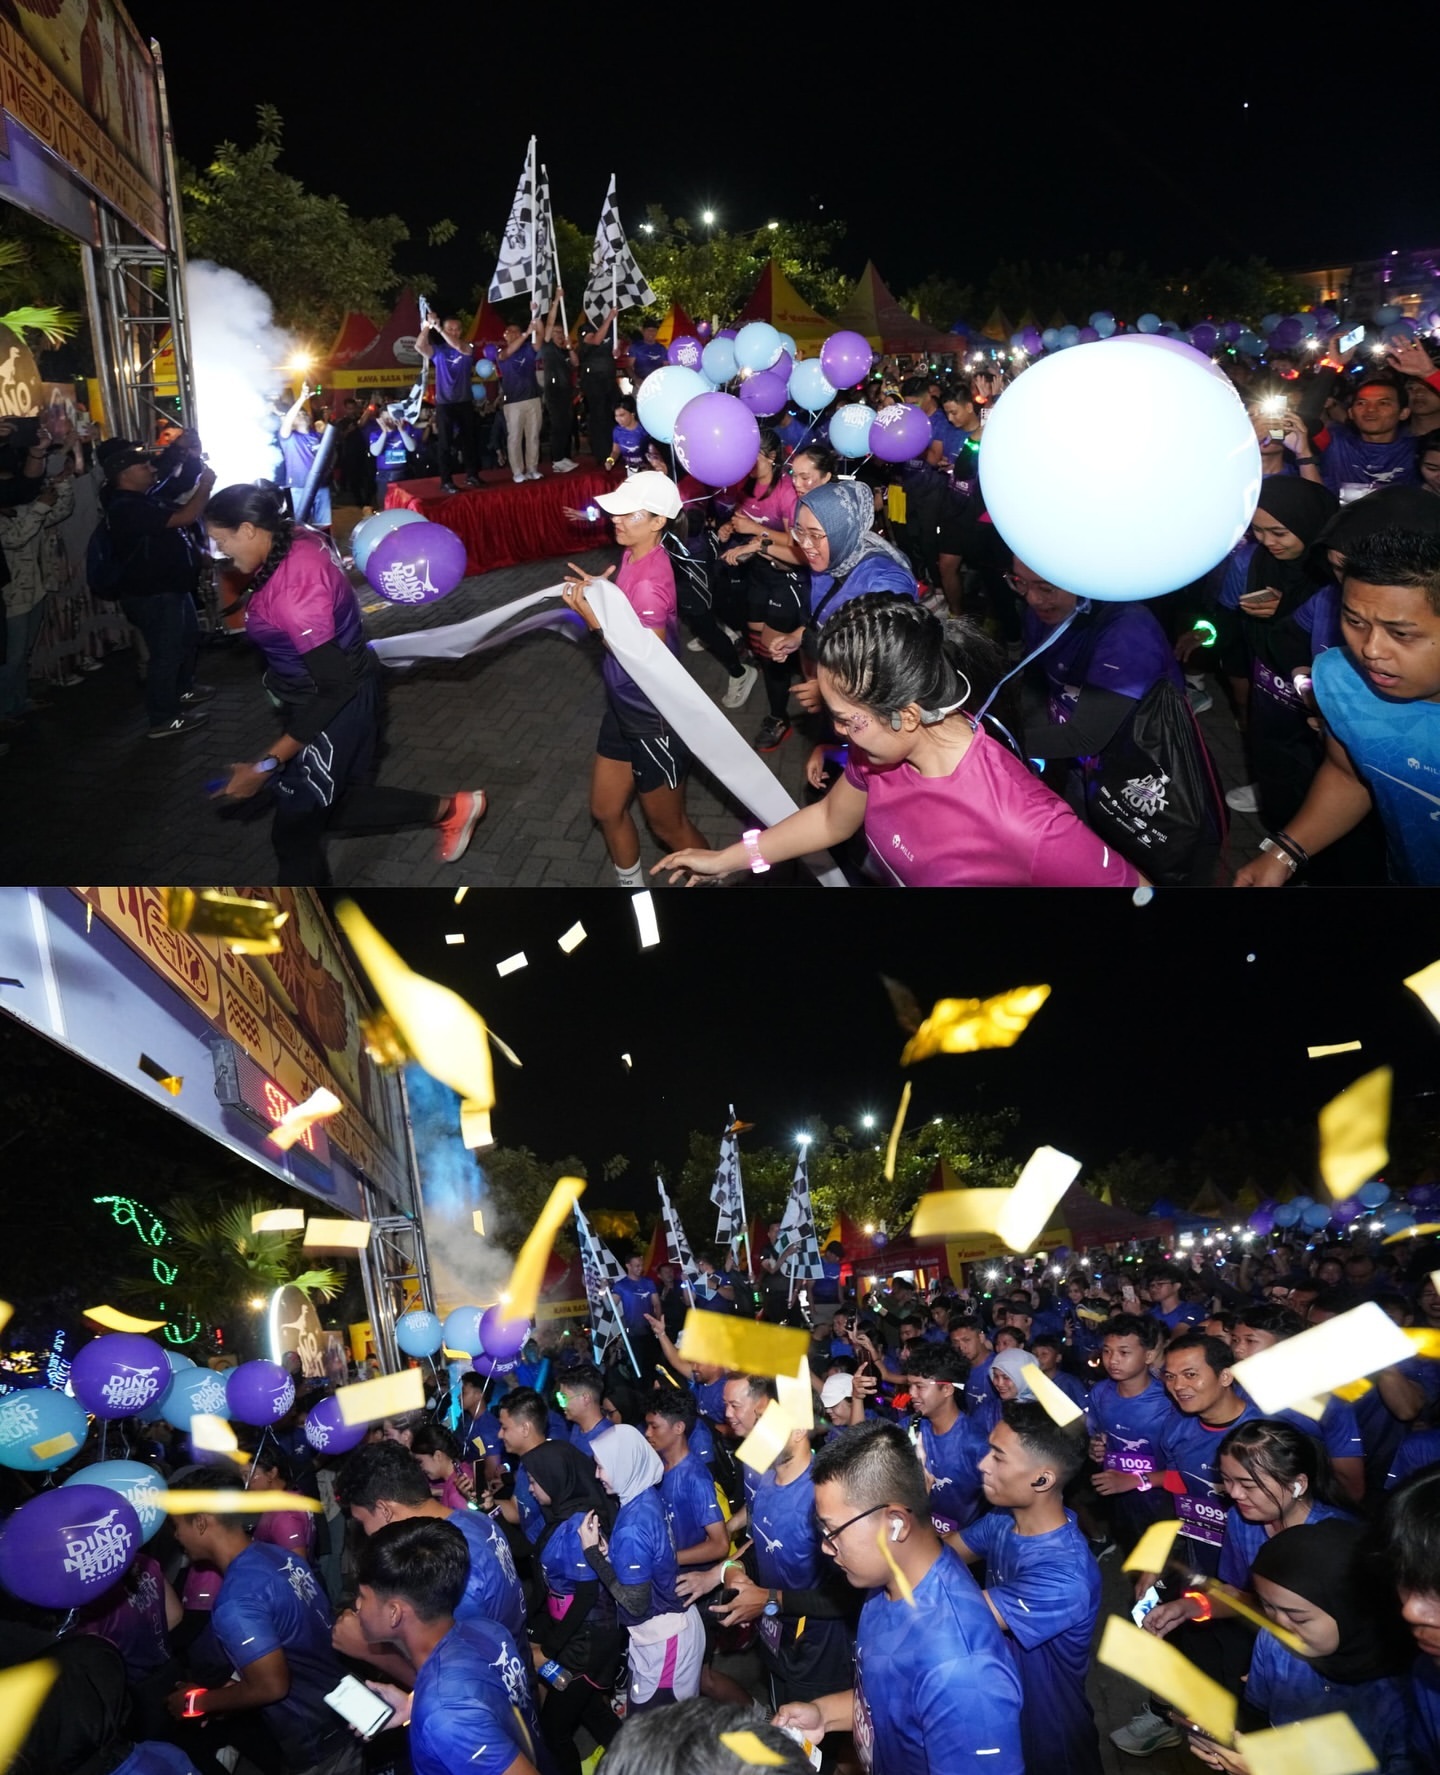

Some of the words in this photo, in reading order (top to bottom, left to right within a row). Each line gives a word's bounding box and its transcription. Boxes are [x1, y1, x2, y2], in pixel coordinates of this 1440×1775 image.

[382, 570, 402, 600] RUN
[401, 563, 425, 601] DINO
[1121, 786, 1157, 816] RUN
[101, 1384, 160, 1400] NIGHT
[108, 1375, 158, 1389] DINO
[190, 1382, 220, 1404] DINO
[273, 1384, 295, 1406] DINO
[107, 1396, 149, 1407] RUN
[1120, 1458, 1153, 1470] 1002
[63, 1532, 133, 1573] NIGHT
[66, 1523, 127, 1558] DINO
[80, 1549, 127, 1581] RUN
